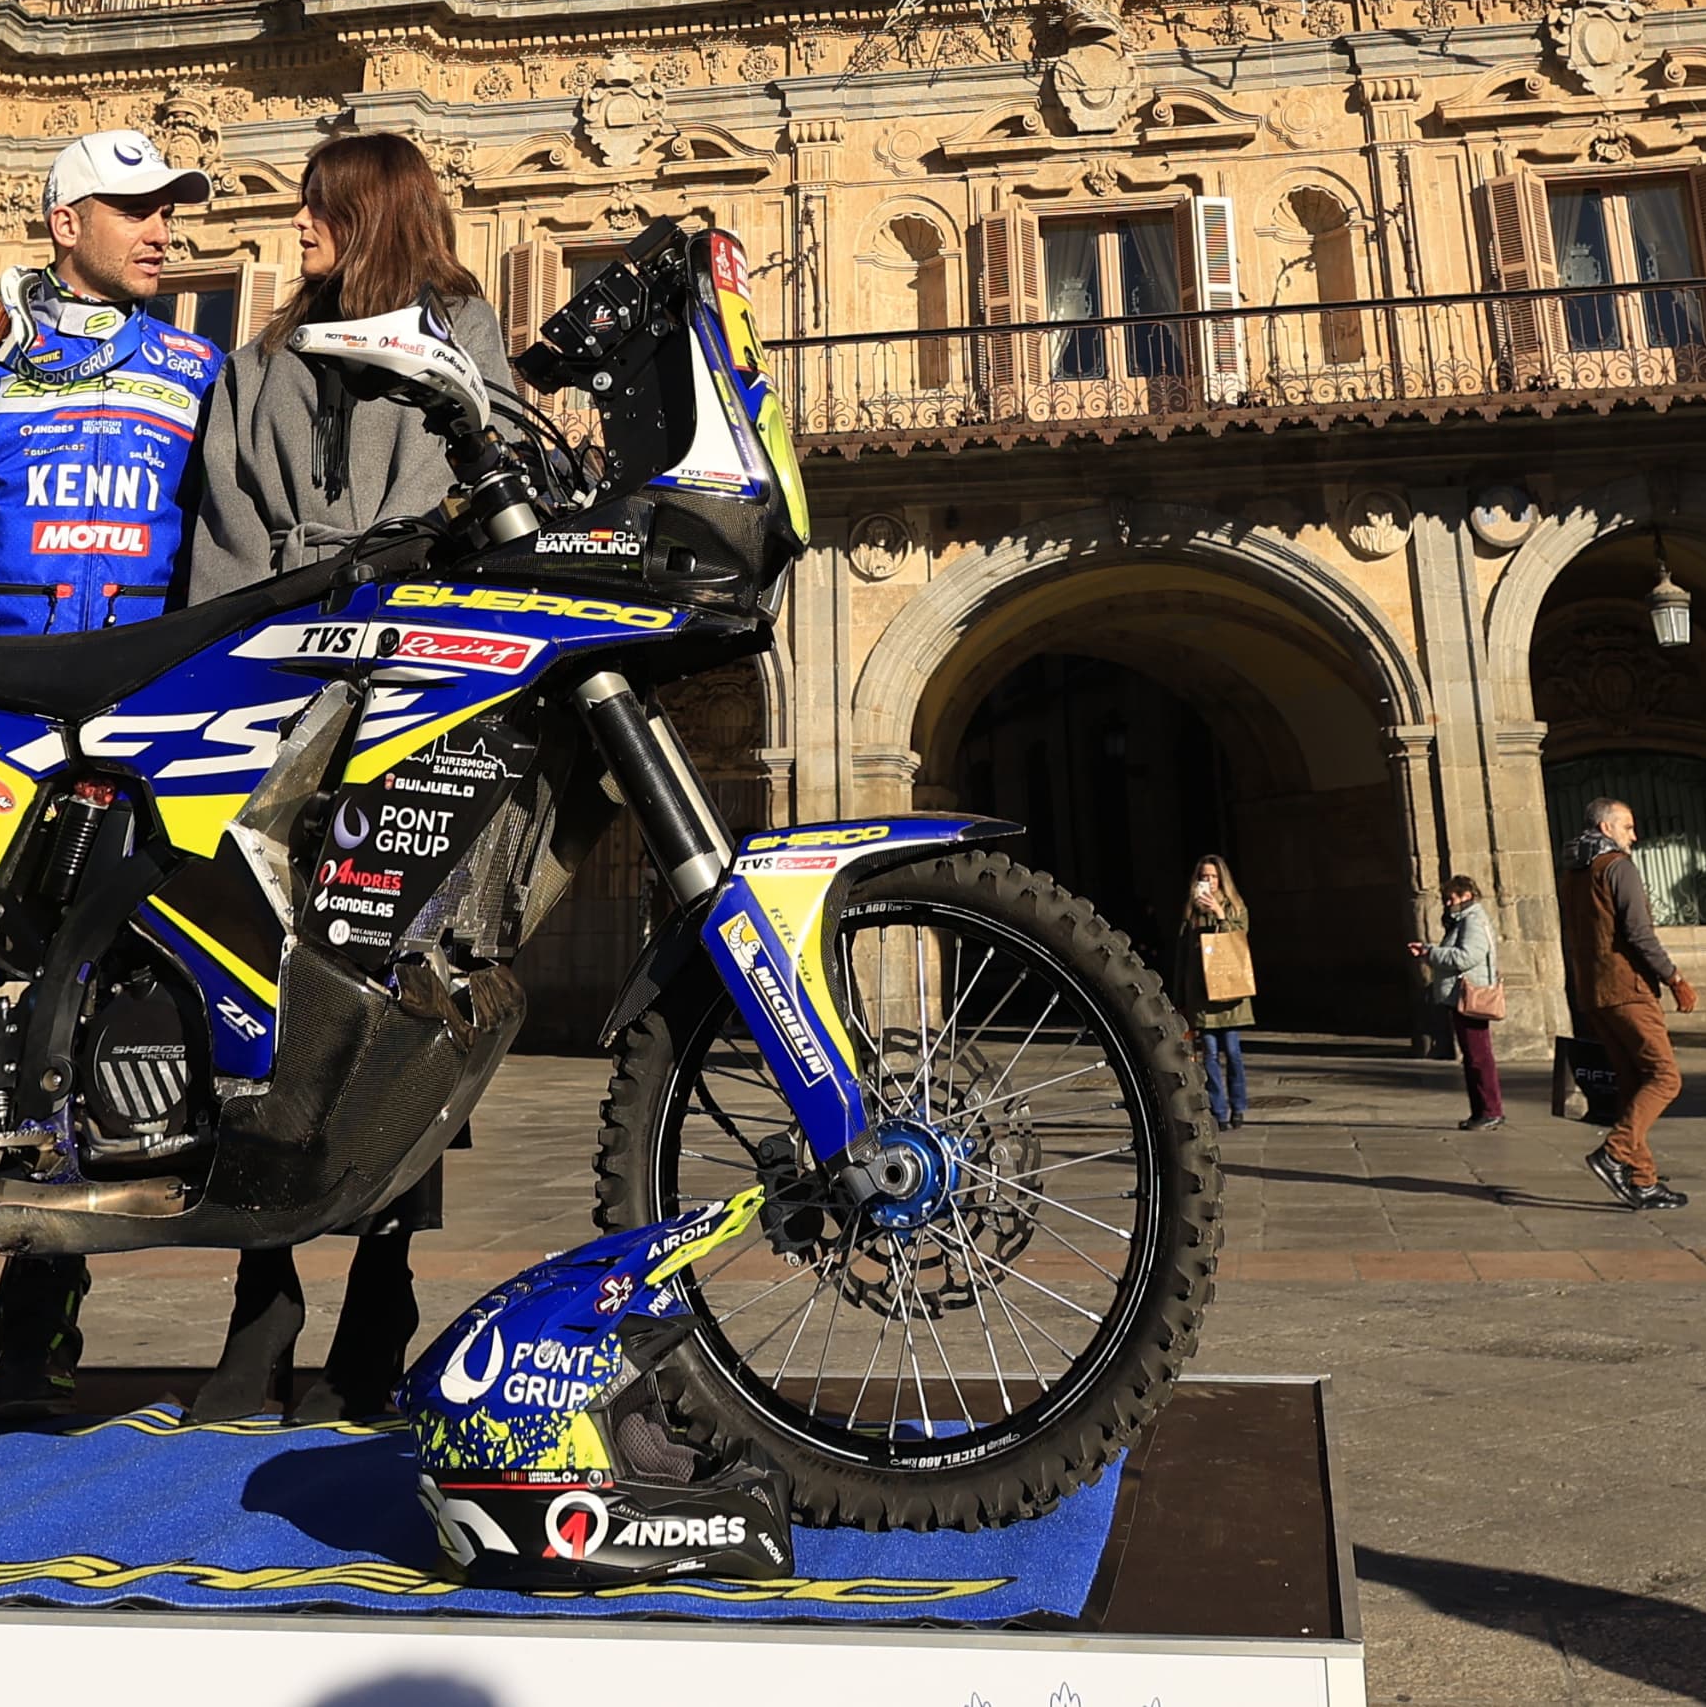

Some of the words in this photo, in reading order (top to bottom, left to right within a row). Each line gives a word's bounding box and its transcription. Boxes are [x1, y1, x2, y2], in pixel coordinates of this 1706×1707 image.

[34, 367, 77, 383] PONT
[79, 343, 115, 376] GRUP
[167, 360, 204, 380] GRUP
[3, 376, 191, 409] SHERCO
[25, 463, 160, 512] KENNY
[38, 524, 145, 552] MOTUL
[534, 540, 641, 556] SANTOLINO
[537, 529, 589, 541] Lorenzo
[385, 584, 676, 629] SHERCO
[295, 626, 358, 654] TVS
[399, 635, 521, 663] Racing
[433, 765, 496, 780] SALAMANCA
[395, 778, 475, 798] GUIJUELO
[380, 805, 454, 834] PONT
[375, 831, 450, 858] GRUP
[747, 826, 890, 850] SHERCO
[739, 857, 774, 871] TVS
[329, 895, 395, 918] CANDELAS
[348, 933, 391, 947] MUNTADA
[754, 965, 825, 1075] MICHELIN
[111, 1045, 186, 1054] SHERCO
[647, 1221, 711, 1261] AIROH
[648, 1288, 675, 1316] PONT
[511, 1342, 596, 1377] PONT
[503, 1372, 589, 1408] GRUP
[599, 1366, 641, 1403] AIROH
[613, 1514, 746, 1547] ANDRÉS
[758, 1531, 784, 1565] AIROH
